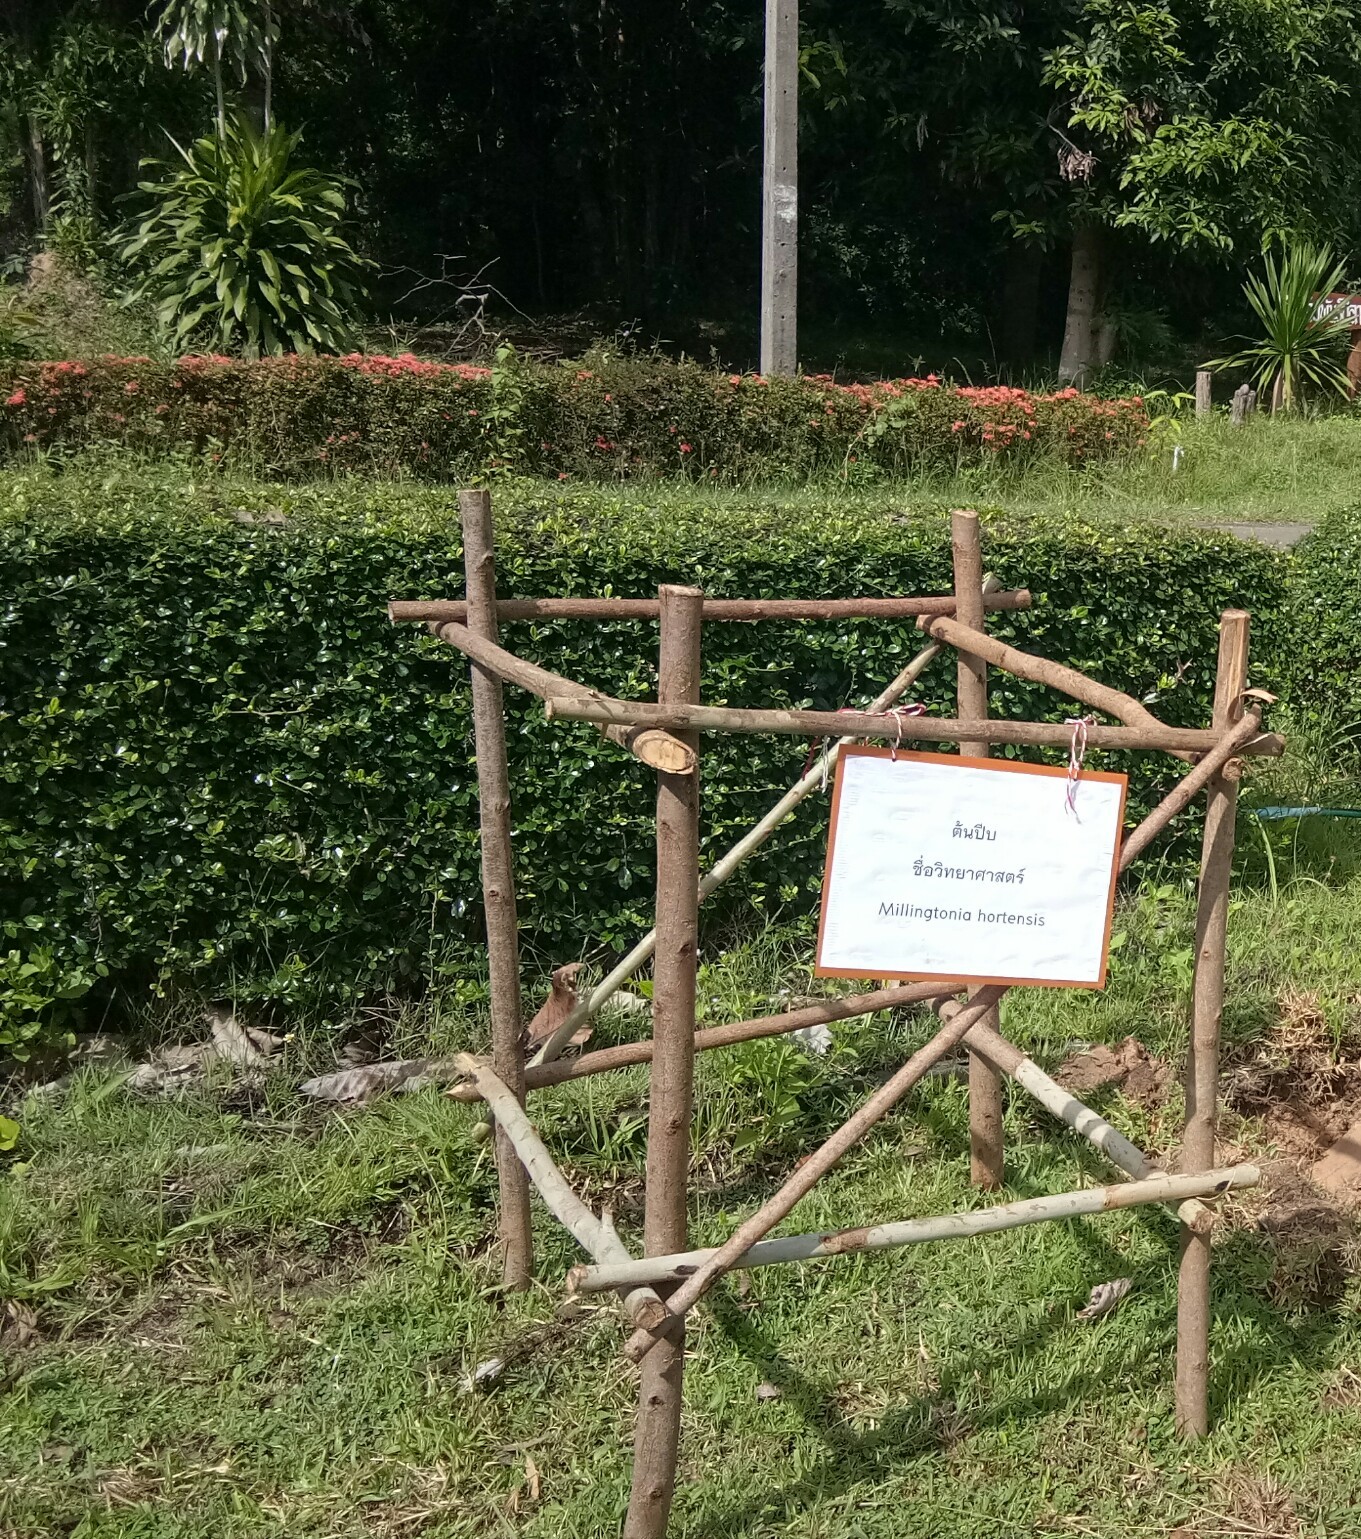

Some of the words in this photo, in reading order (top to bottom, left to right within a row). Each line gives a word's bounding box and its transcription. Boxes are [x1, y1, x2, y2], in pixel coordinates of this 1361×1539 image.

[952, 820, 997, 841] ต้นปีบ
[912, 855, 1026, 885] ชื่อวิทยาศาสตร์
[878, 901, 972, 922] Millingtonia
[977, 909, 1046, 927] hortensis
